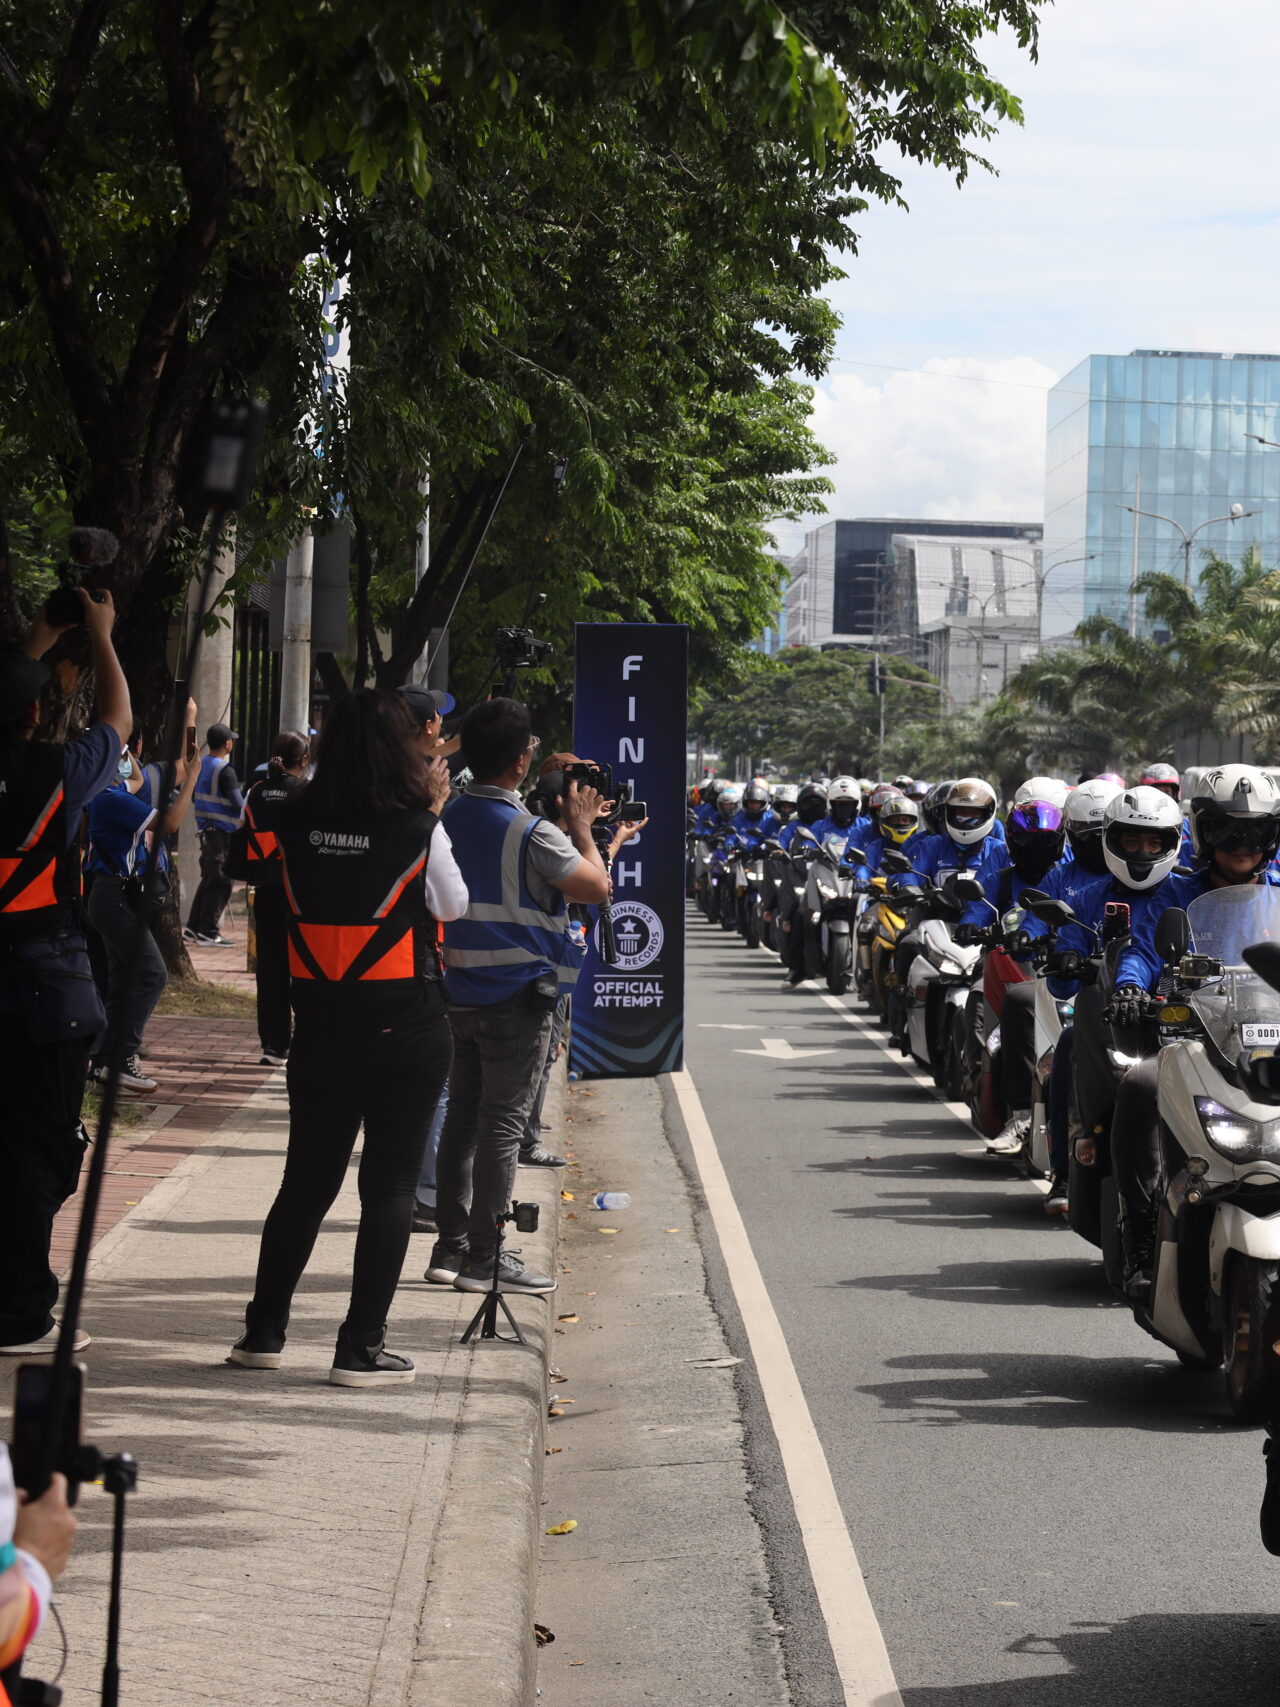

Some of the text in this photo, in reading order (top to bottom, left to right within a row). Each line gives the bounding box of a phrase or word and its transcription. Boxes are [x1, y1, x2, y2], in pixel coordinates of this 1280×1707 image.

[324, 832, 370, 849] YAMAHA
[610, 905, 654, 924] UINNESS
[625, 931, 660, 966] RECORDS
[593, 981, 664, 994] OFFICIAL
[593, 995, 664, 1007] ATTEMPT
[1257, 1028, 1280, 1038] 0001
